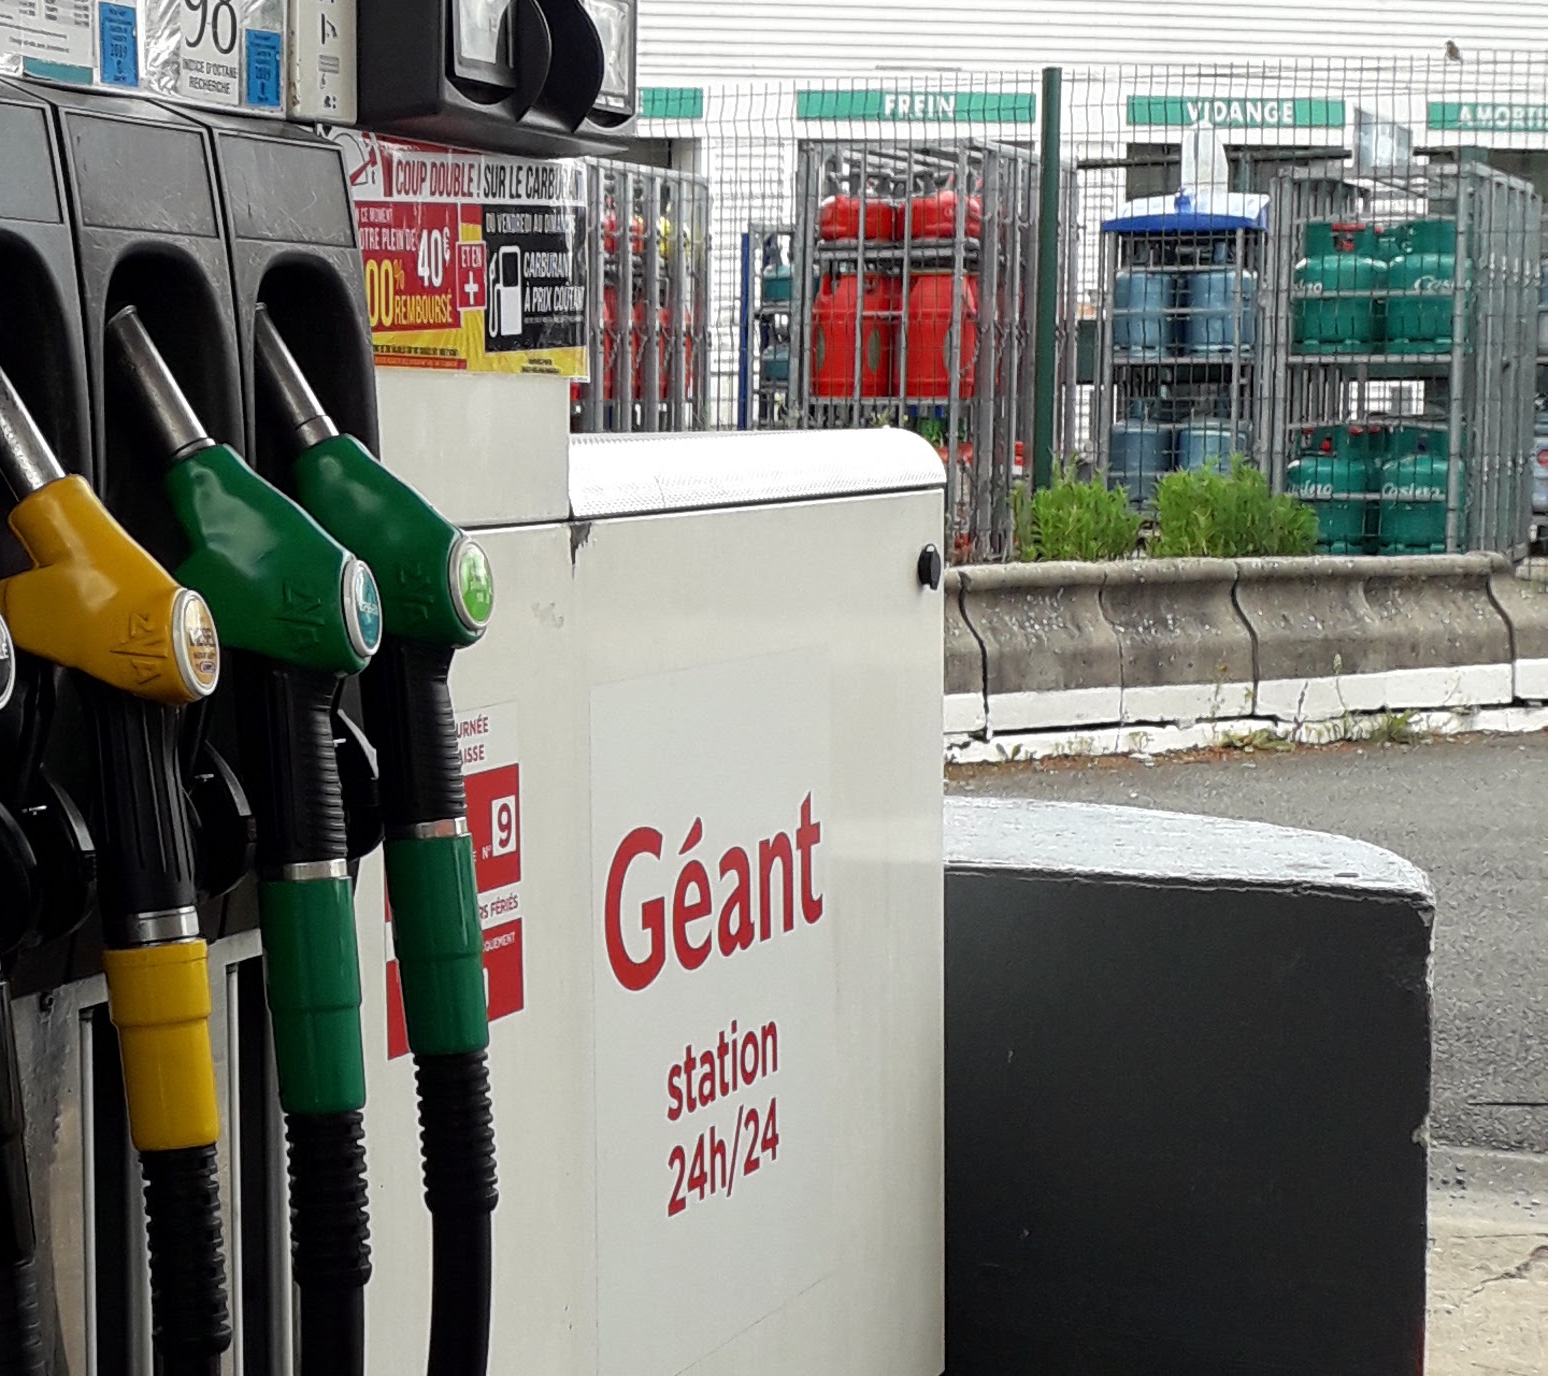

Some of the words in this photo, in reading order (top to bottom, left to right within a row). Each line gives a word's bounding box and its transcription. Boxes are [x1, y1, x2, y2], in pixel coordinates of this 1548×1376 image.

[189, 75, 231, 95] RECHERCHE
[884, 94, 955, 118] FREIN
[1186, 101, 1294, 124] VIDANGE
[1458, 105, 1548, 128] AMORTI
[395, 159, 428, 196] COUP
[430, 160, 475, 198] DOUBLE
[483, 164, 506, 199] SUR
[509, 165, 523, 199] LE
[358, 227, 380, 251] OTRE
[381, 227, 404, 251] PLEIN
[461, 245, 471, 268] ET
[472, 246, 482, 268] EN
[395, 287, 453, 326] REMBOURSÉ
[532, 285, 553, 312] PRIX
[456, 713, 489, 739] URNÉE
[459, 744, 485, 764] AISSE
[497, 802, 513, 850] 9
[604, 792, 824, 992] Géant
[667, 1019, 780, 1122] station
[667, 1097, 780, 1218] 24h/24
